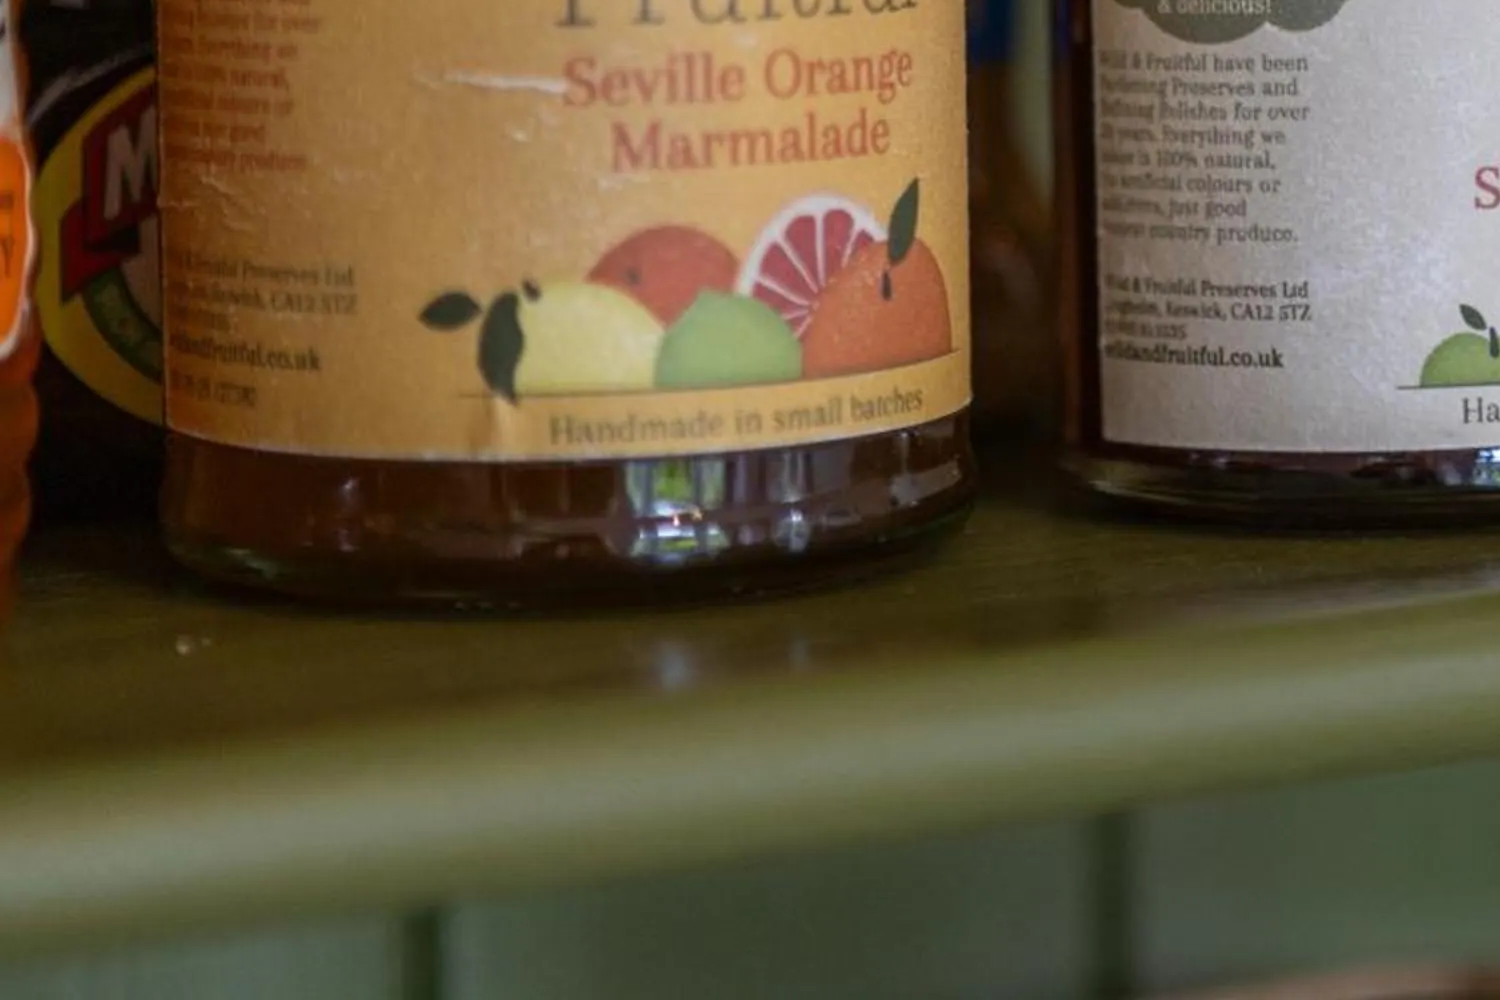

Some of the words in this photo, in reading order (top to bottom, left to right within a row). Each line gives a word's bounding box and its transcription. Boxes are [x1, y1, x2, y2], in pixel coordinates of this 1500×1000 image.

[1213, 53, 1256, 73] have
[1261, 53, 1309, 72] been
[562, 50, 746, 108] Seville
[764, 47, 914, 105] Orange
[1172, 78, 1256, 98] Preserves
[1261, 77, 1298, 97] and
[1234, 101, 1262, 121] for
[1267, 106, 1311, 122] over
[610, 107, 892, 175] Marmalade
[1260, 129, 1287, 144] we
[1186, 173, 1253, 193] colours
[1257, 176, 1282, 193] or
[1204, 199, 1248, 221] good
[1216, 223, 1300, 246] produce.
[1200, 278, 1278, 299] Preserves
[1282, 279, 1310, 299] Ltd
[1230, 303, 1274, 321] CA12
[1279, 304, 1312, 322] 5TZ
[550, 409, 724, 446] Handmade
[734, 410, 763, 437] in
[772, 398, 843, 432] small
[850, 385, 924, 419] batches
